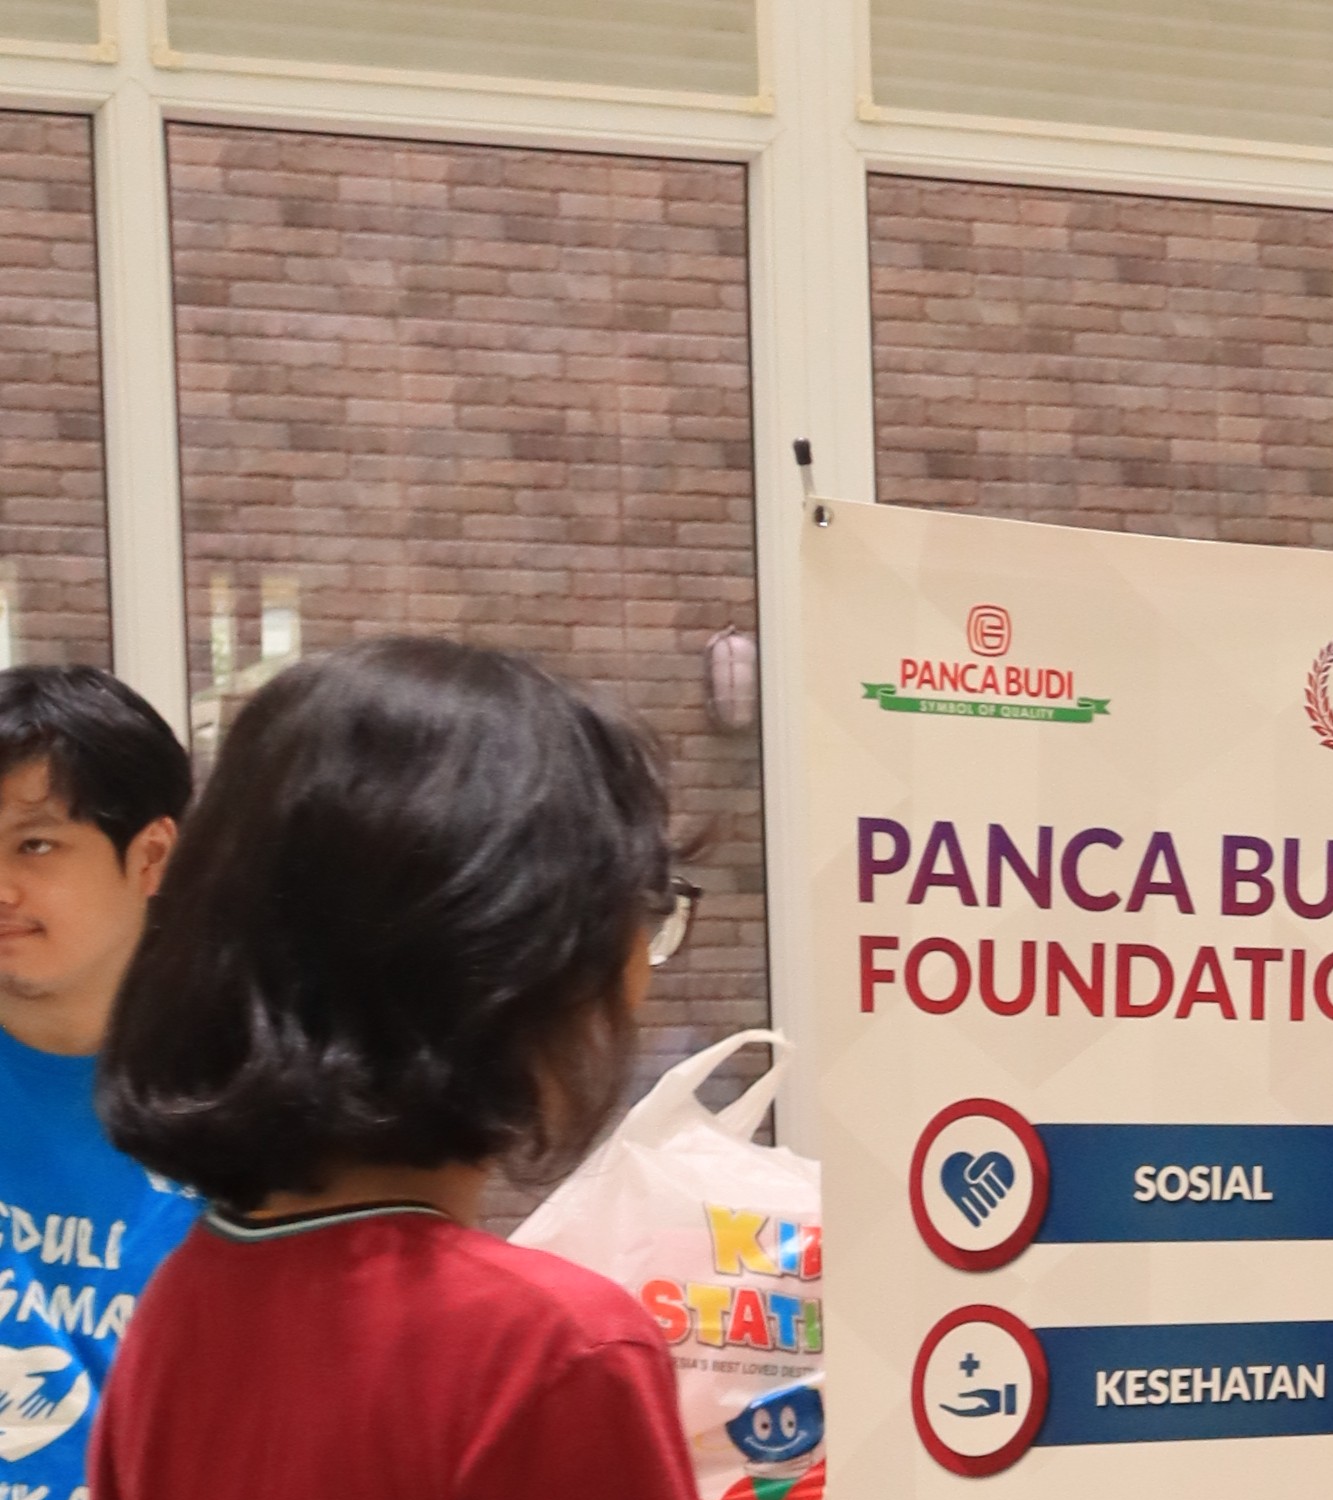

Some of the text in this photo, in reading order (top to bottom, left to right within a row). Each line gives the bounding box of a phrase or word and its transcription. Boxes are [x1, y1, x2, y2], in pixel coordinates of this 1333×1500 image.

[901, 658, 1074, 700] PANCA BUDI
[919, 700, 1055, 720] SYMBOL OF QUALITY
[857, 816, 1196, 915] PANCA
[1133, 1165, 1273, 1202] SOSIAL
[0, 1202, 127, 1270] DULI
[711, 1360, 741, 1374] BEST
[743, 1363, 778, 1377] LOVED
[1096, 1363, 1326, 1408] KESEHATAN
